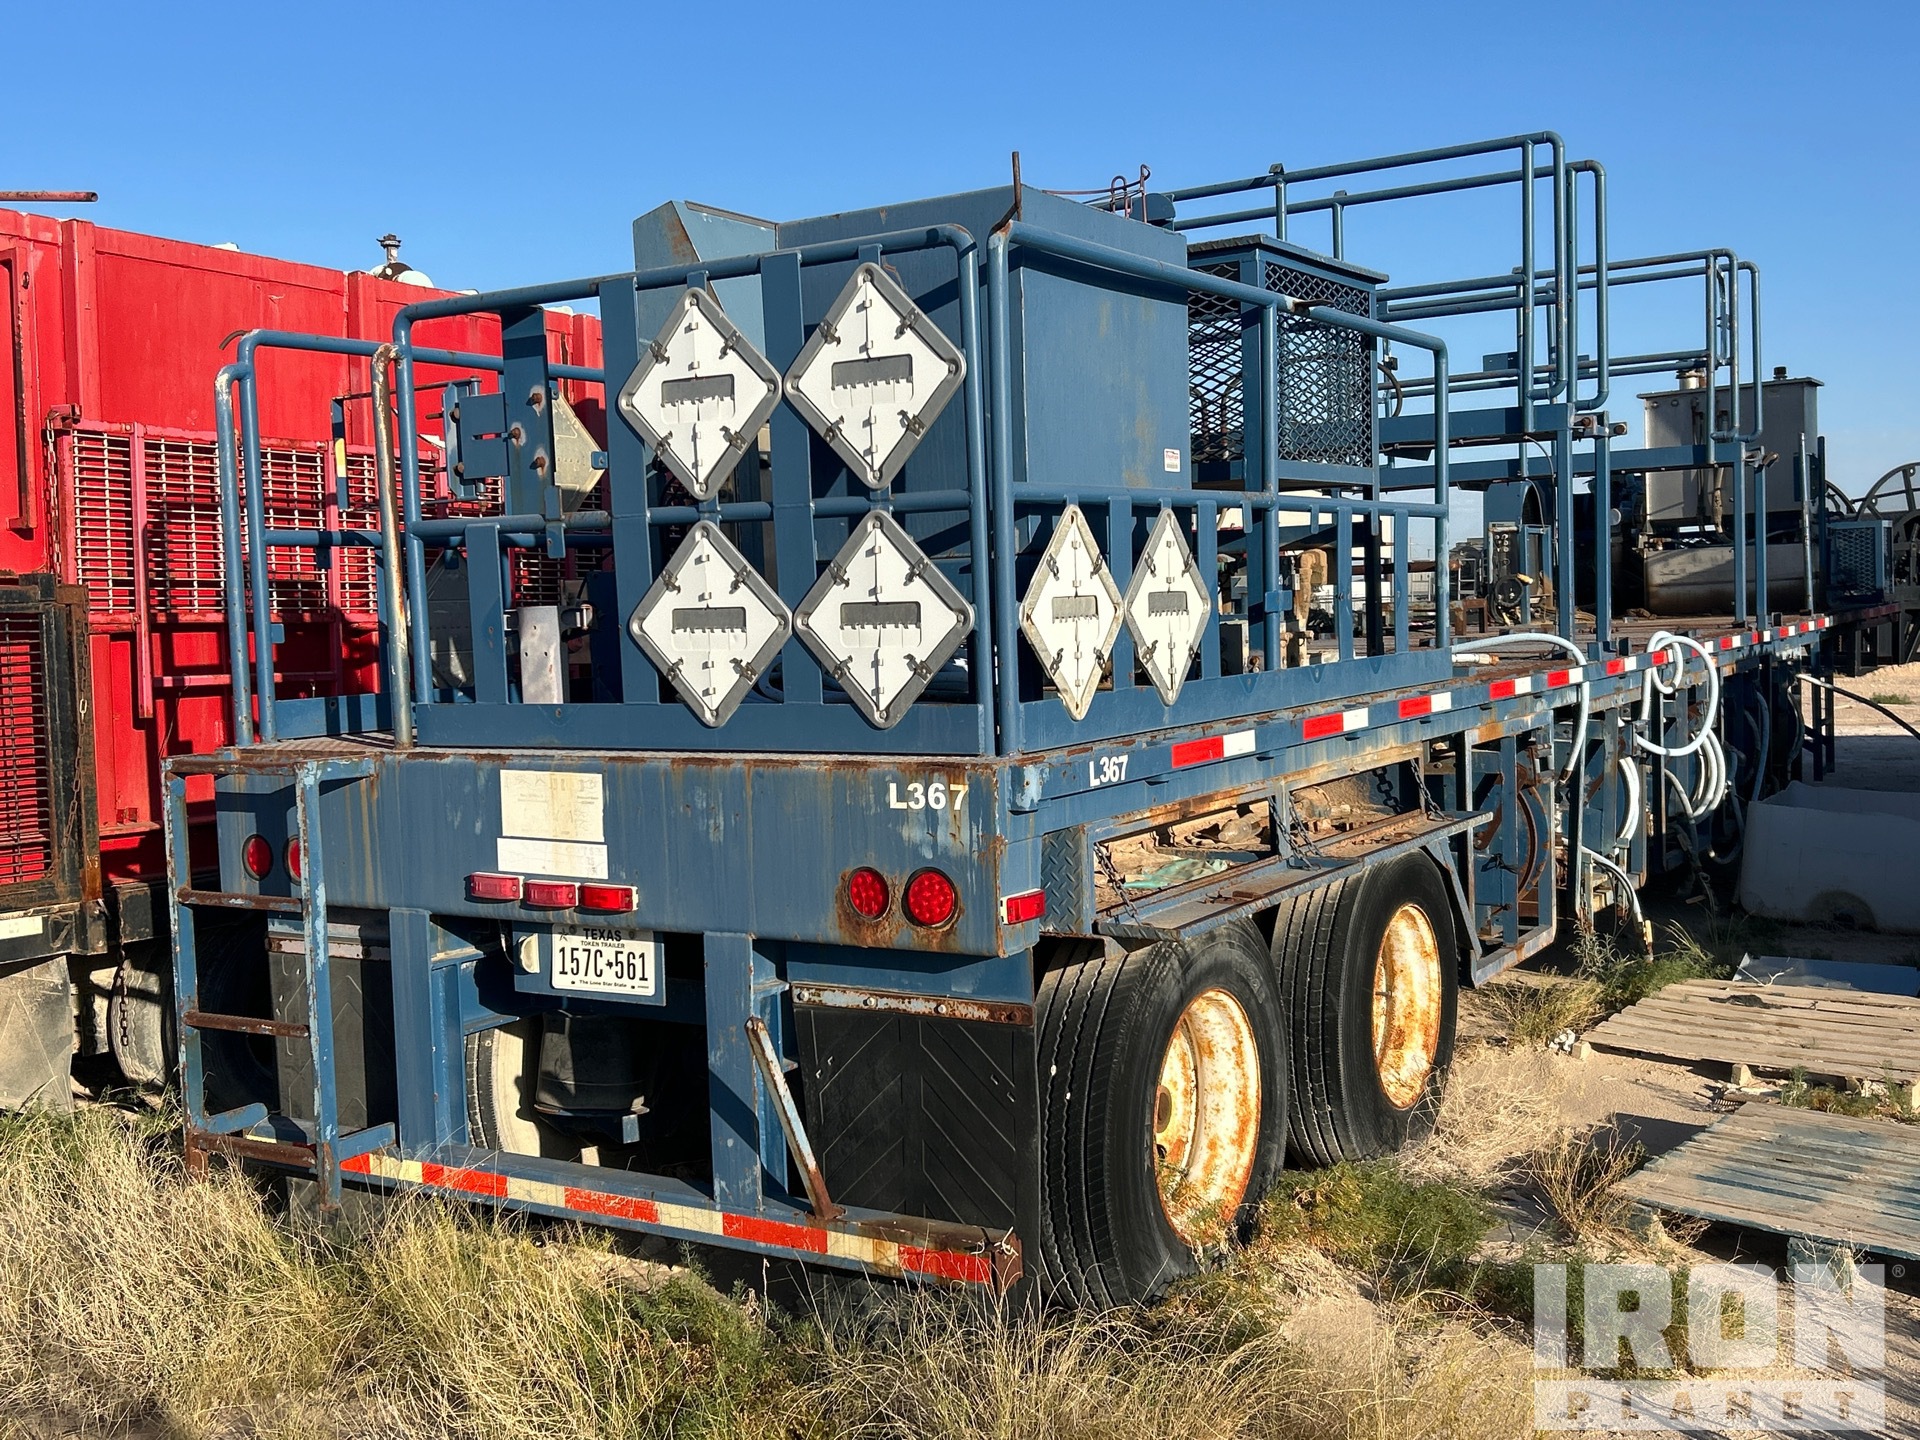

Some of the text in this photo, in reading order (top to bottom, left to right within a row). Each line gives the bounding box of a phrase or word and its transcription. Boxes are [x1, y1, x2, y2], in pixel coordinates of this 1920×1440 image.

[1089, 755, 1129, 787] L367
[889, 782, 969, 811] L367
[583, 928, 621, 941] TEXAS
